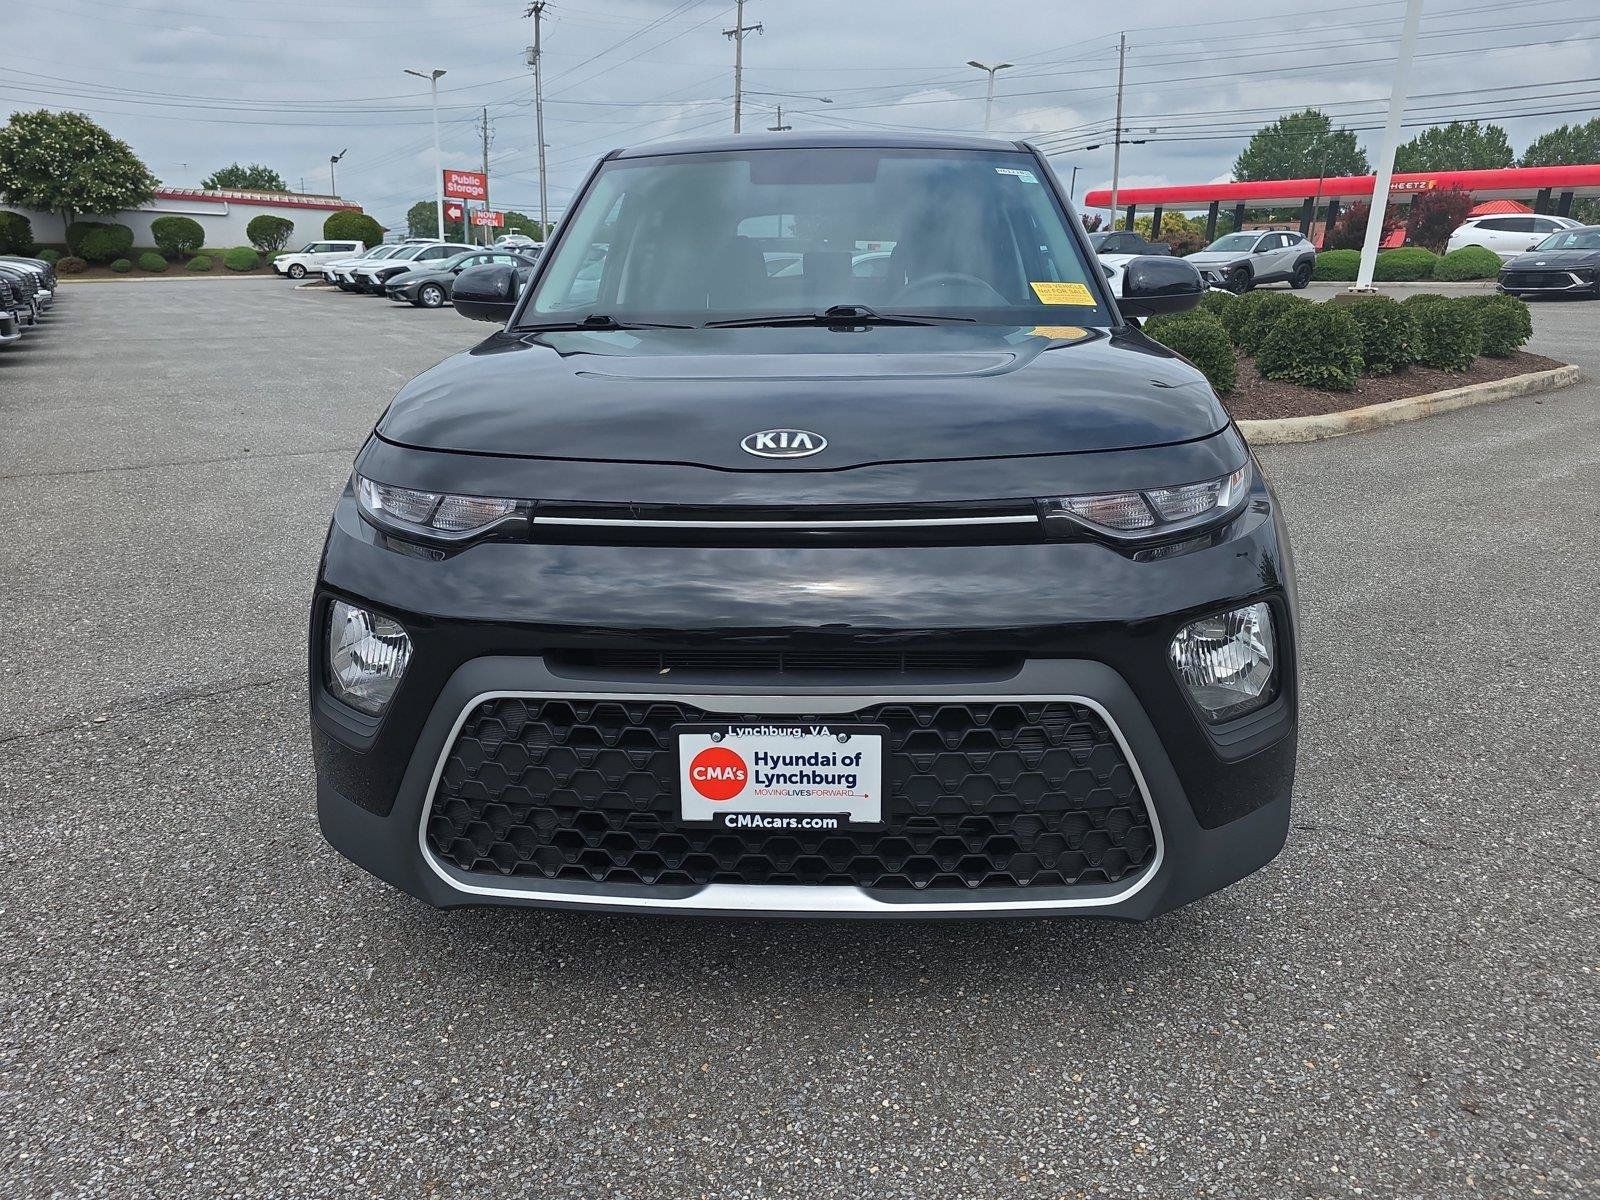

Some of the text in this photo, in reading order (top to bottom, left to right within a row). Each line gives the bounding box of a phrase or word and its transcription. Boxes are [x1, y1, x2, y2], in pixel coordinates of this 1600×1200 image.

[452, 174, 480, 185] Public
[448, 183, 484, 195] Storage
[477, 211, 496, 219] NOW
[756, 432, 813, 449] KIA
[728, 725, 831, 738] Lynchburg, VA
[754, 751, 862, 769] Hyundai of
[692, 766, 745, 782] CMA's
[754, 770, 858, 788] Lynchburg
[724, 814, 838, 829] CMAcars.com
